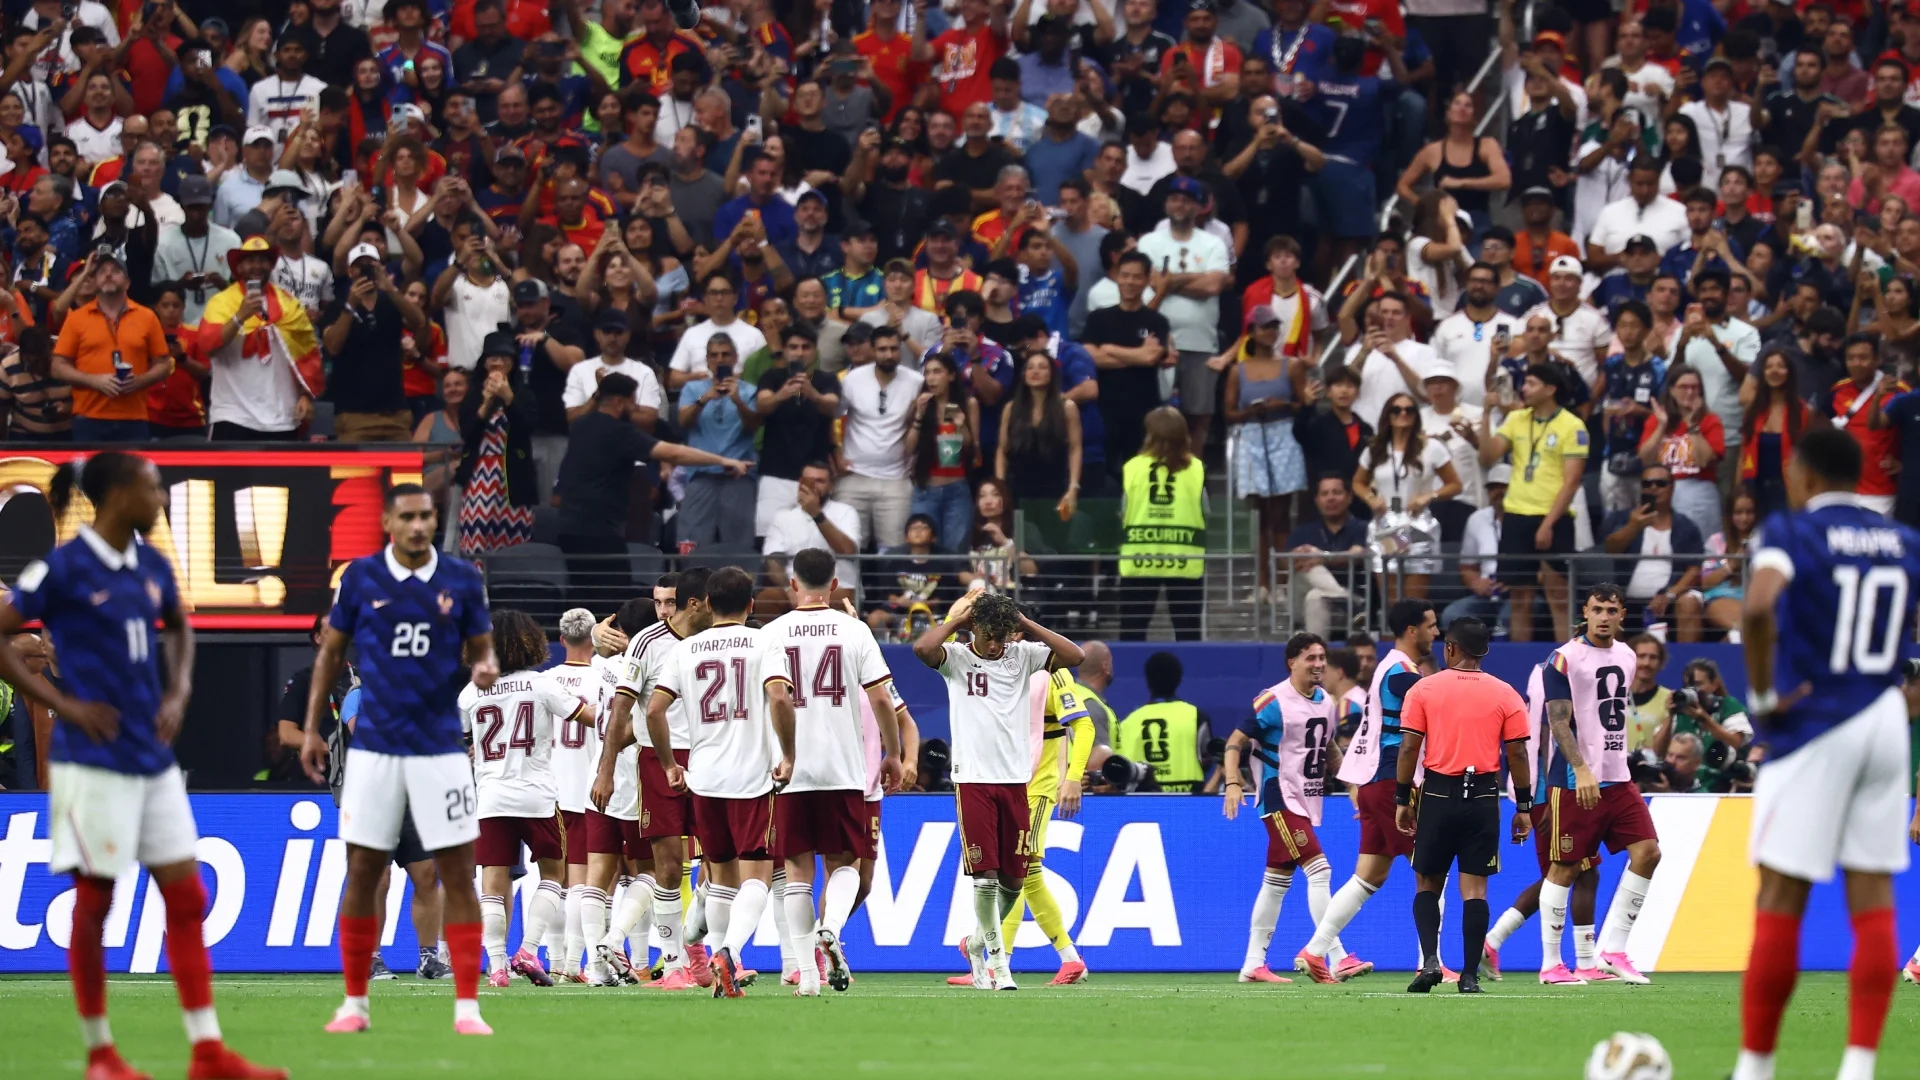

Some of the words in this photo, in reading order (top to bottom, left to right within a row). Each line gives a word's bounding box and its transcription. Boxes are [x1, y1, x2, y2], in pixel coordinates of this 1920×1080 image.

[1325, 99, 1349, 138] 7
[1127, 528, 1195, 543] SECURITY
[788, 623, 838, 638] LAPORTE
[1829, 564, 1909, 675] 10
[125, 618, 149, 663] 11
[391, 622, 431, 657] 26
[690, 636, 755, 654] OYARZABAL
[477, 680, 533, 698] COCURELLA
[695, 656, 748, 724] 21
[785, 644, 847, 708] 14
[966, 671, 989, 697] 19
[476, 700, 536, 762] 24
[445, 784, 475, 821] 26
[1015, 829, 1031, 855] 19
